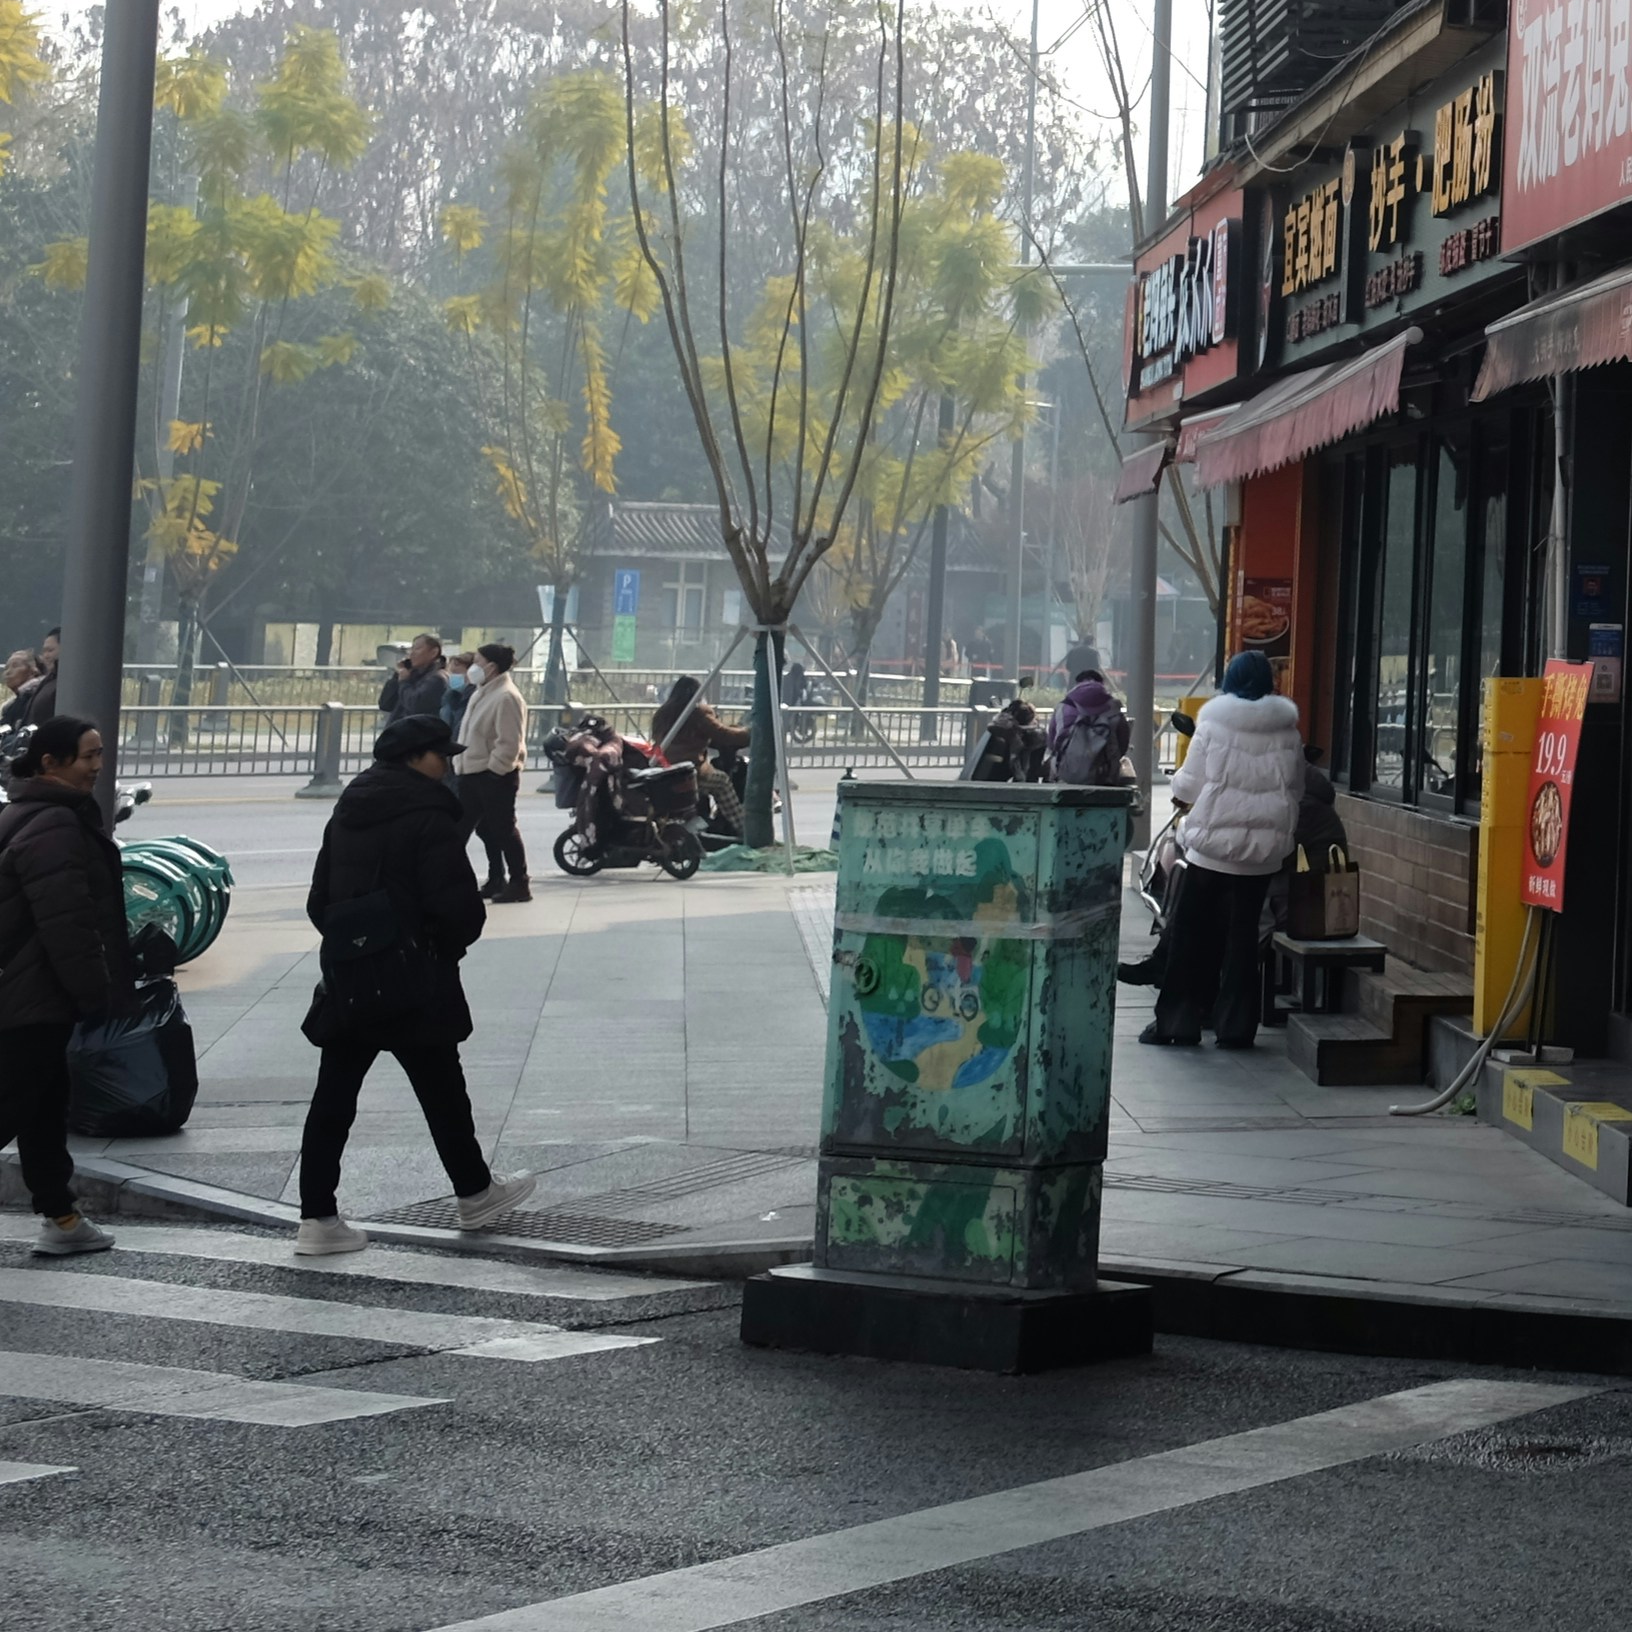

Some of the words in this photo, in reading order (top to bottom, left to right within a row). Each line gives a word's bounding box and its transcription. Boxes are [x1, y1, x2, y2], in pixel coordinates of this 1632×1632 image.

[1540, 671, 1588, 722] 手撕烤兔
[1535, 730, 1568, 776] 19.9
[862, 847, 978, 877] 从你我做起
[1528, 872, 1557, 900] 新鲜现做
